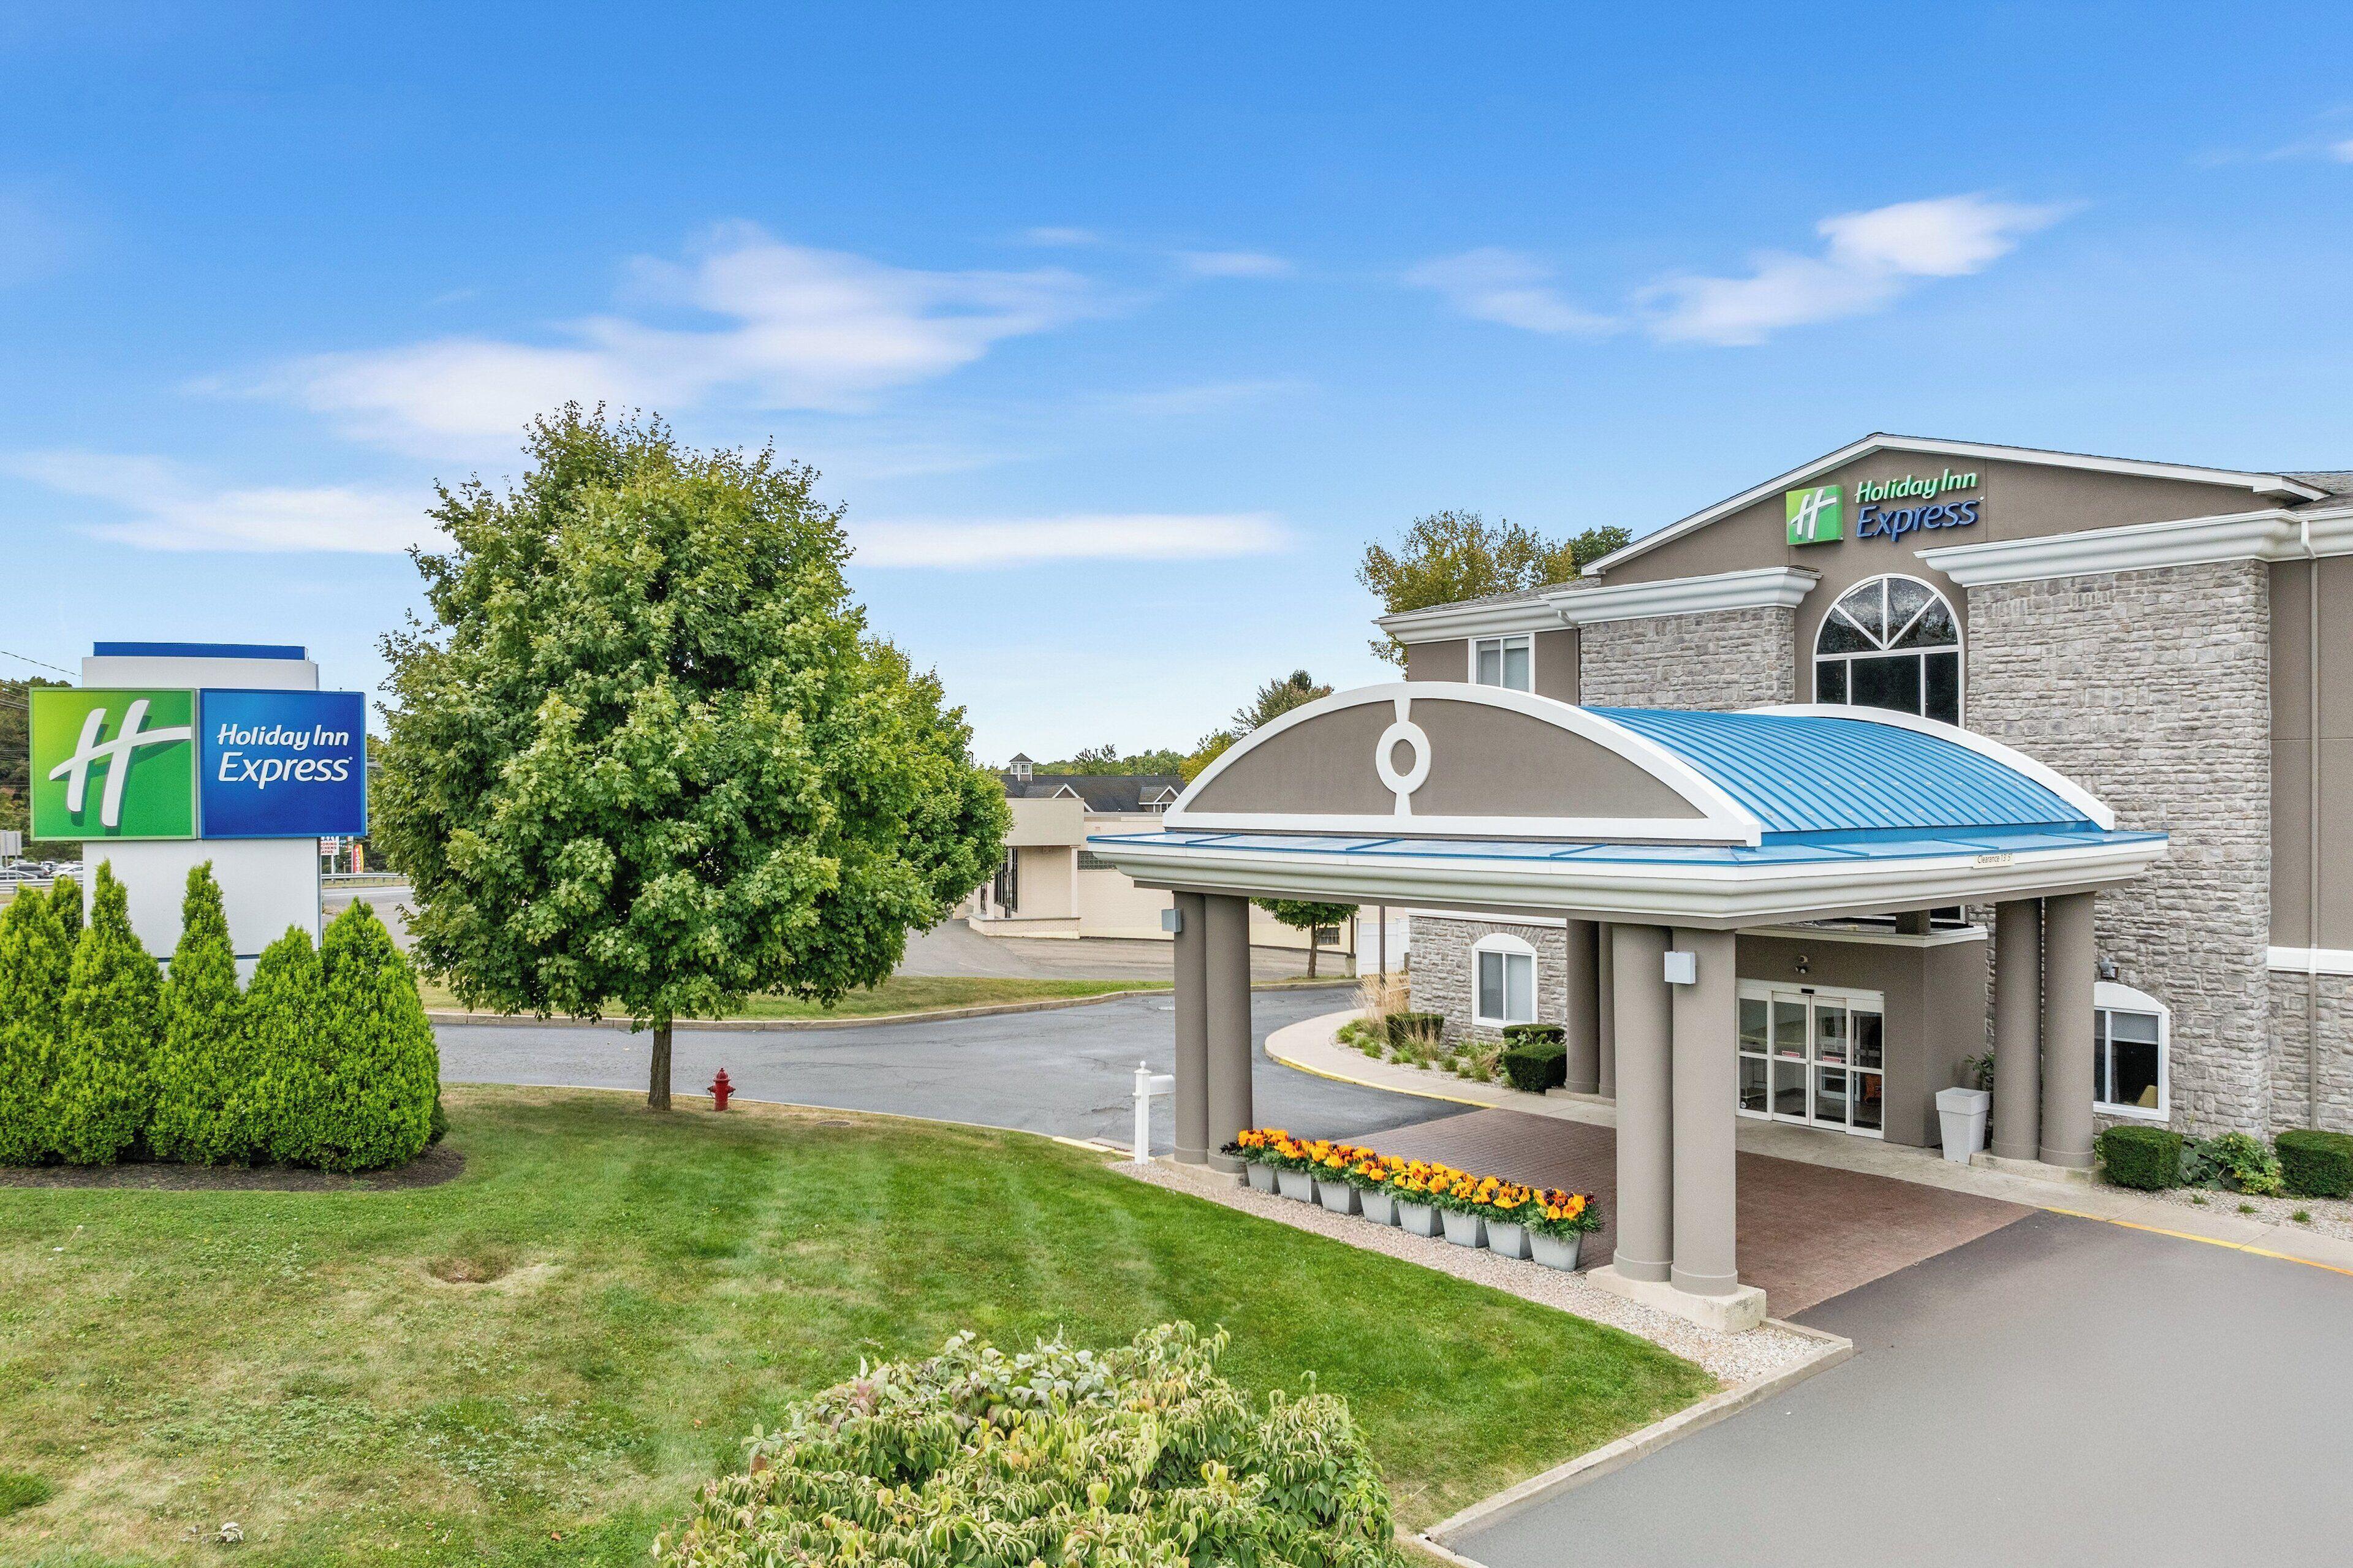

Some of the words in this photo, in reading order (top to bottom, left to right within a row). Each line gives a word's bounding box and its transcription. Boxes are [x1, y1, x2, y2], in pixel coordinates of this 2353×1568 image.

[1854, 474, 1939, 504] Holiday
[1941, 468, 1978, 492] Inn
[1855, 499, 1980, 542] Express
[216, 723, 310, 751] Holiday
[313, 724, 349, 746] Inn
[218, 751, 350, 790] Express
[1977, 855, 1999, 863] Clearance
